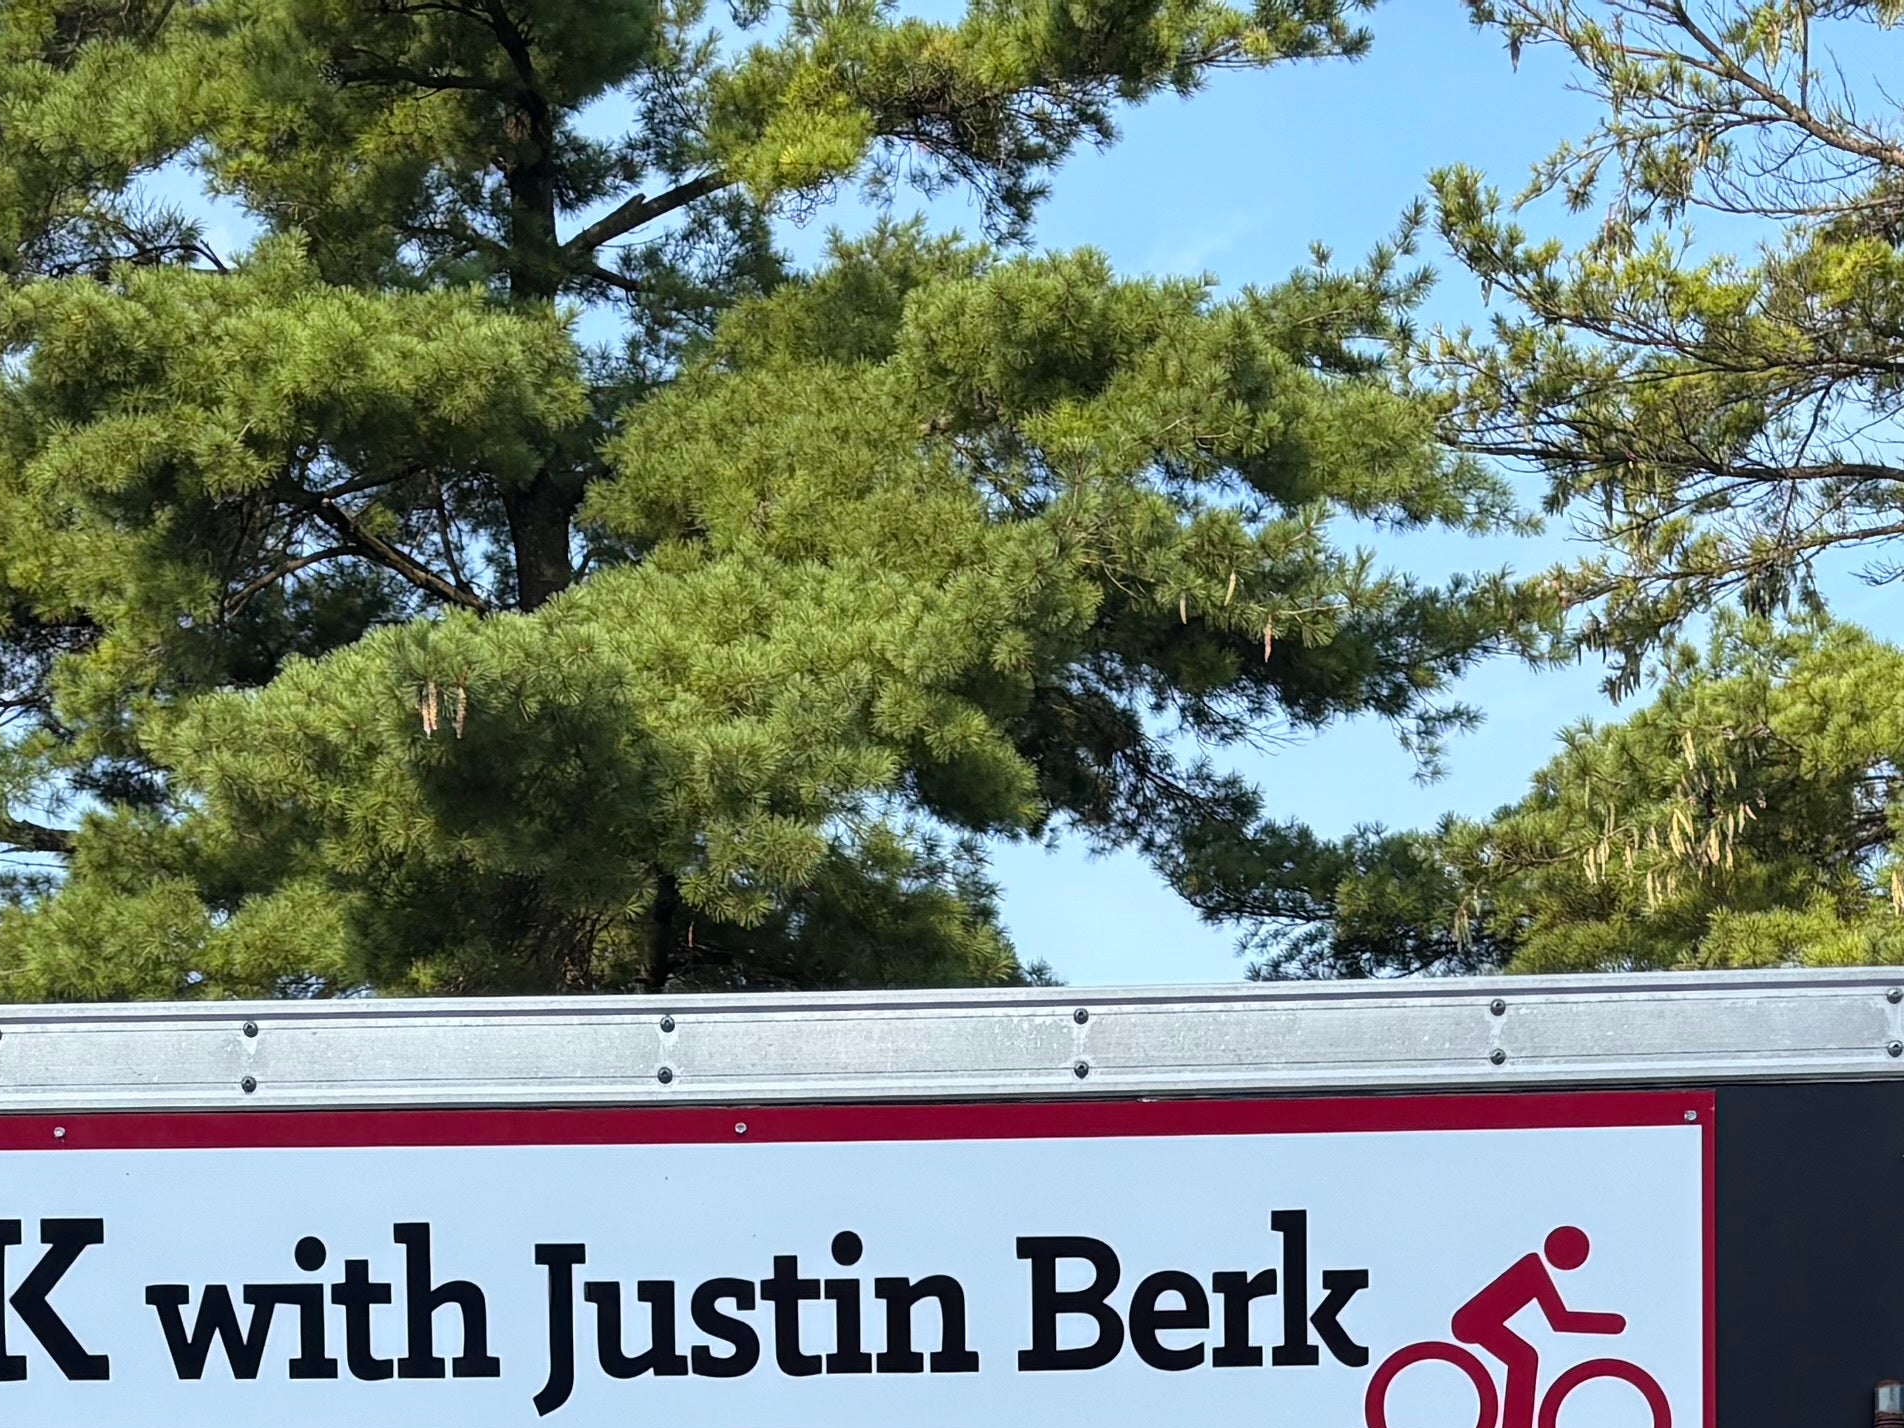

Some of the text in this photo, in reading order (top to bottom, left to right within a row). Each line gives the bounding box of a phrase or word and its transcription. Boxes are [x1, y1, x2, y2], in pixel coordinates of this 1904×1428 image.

[145, 1222, 501, 1382] with
[532, 1230, 980, 1417] Justin
[1015, 1209, 1370, 1372] Berk
